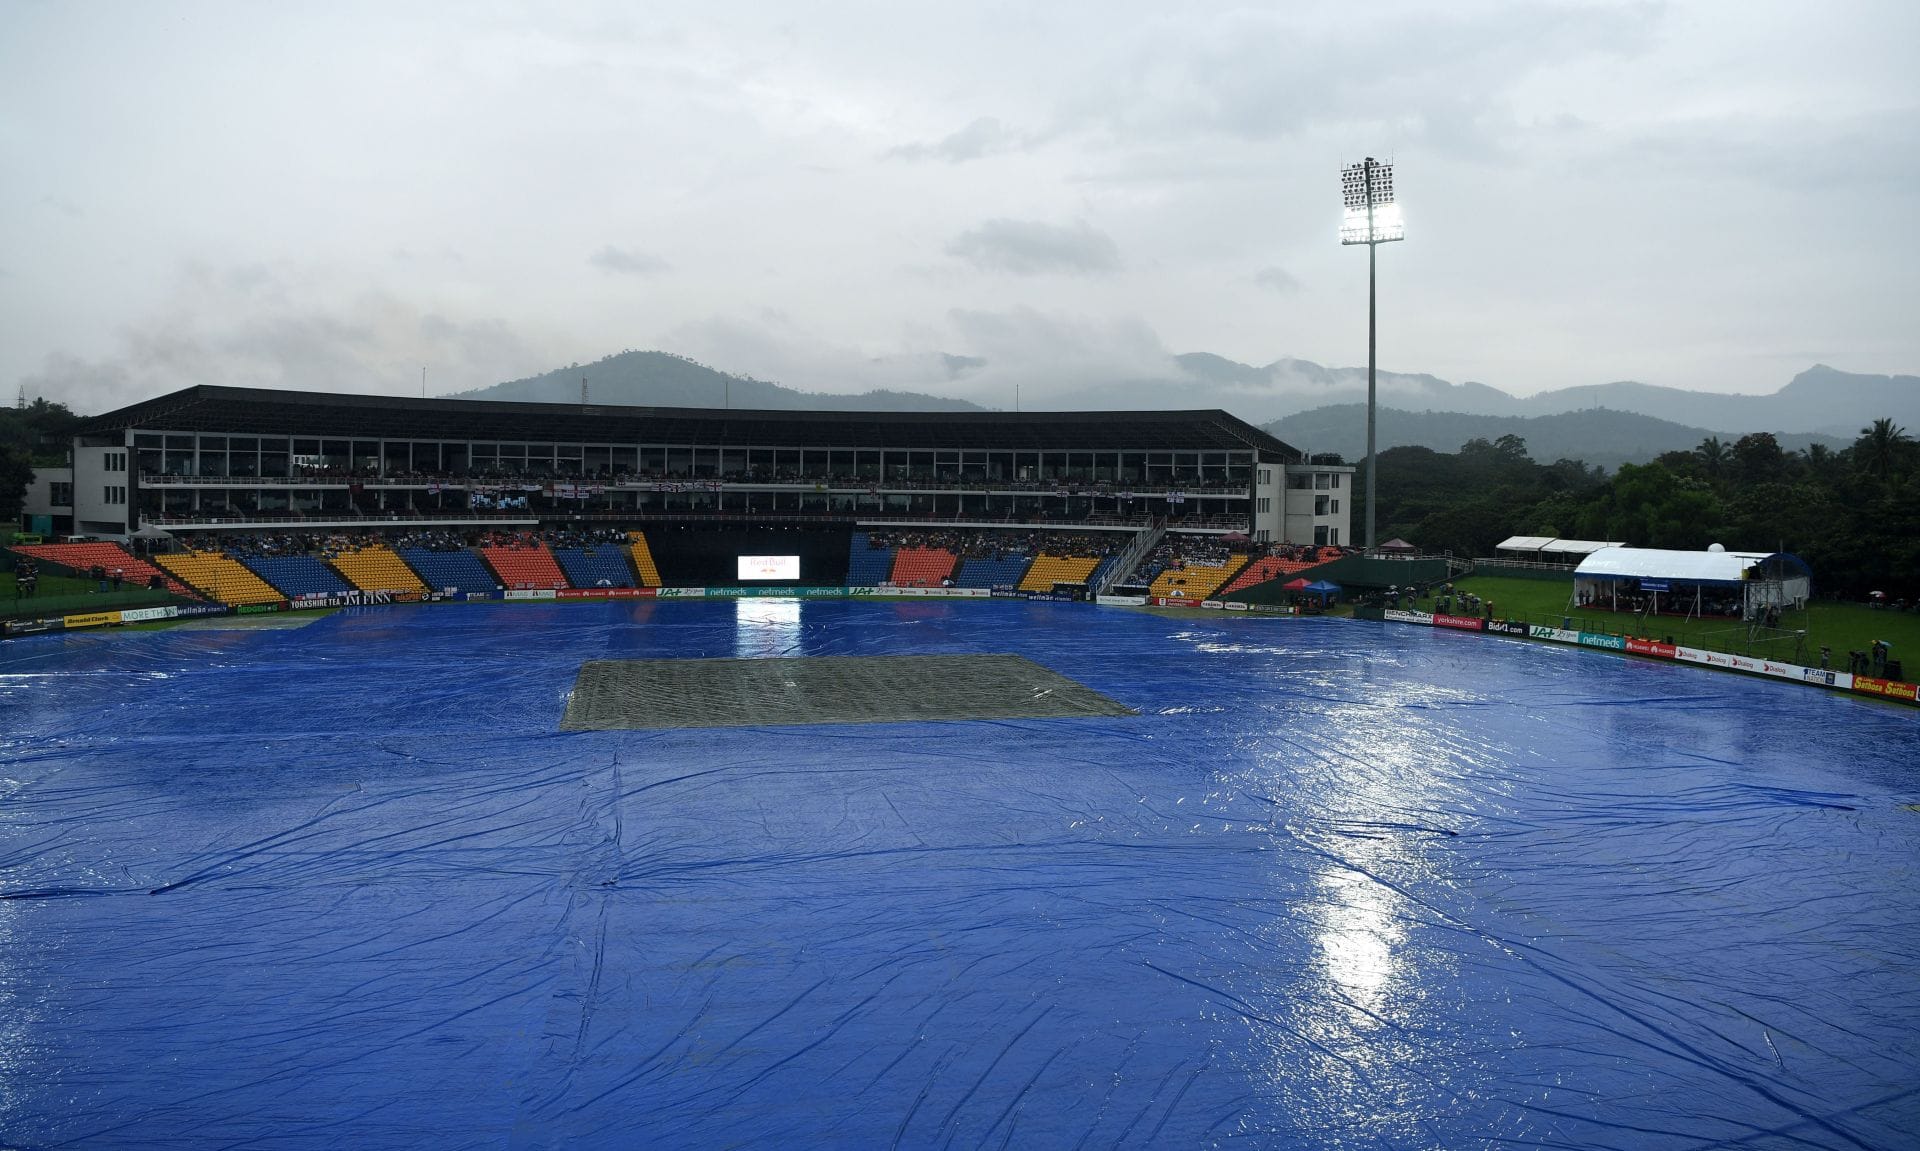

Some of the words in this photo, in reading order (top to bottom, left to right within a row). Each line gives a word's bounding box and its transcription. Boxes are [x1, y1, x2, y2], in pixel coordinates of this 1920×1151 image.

[710, 588, 746, 596] netmeds
[758, 588, 795, 596] netmeds
[806, 588, 842, 596] netmeds
[291, 599, 327, 609] YORKSHIRE
[328, 598, 341, 606] TEA
[123, 610, 149, 620] MORE
[1437, 616, 1477, 627] yorkshire.com
[1583, 635, 1620, 648] netmeds
[1711, 655, 1726, 664] Dialog
[1737, 659, 1753, 669] Dialog
[1769, 664, 1786, 675] Dialog
[1807, 668, 1826, 677] TEAM
